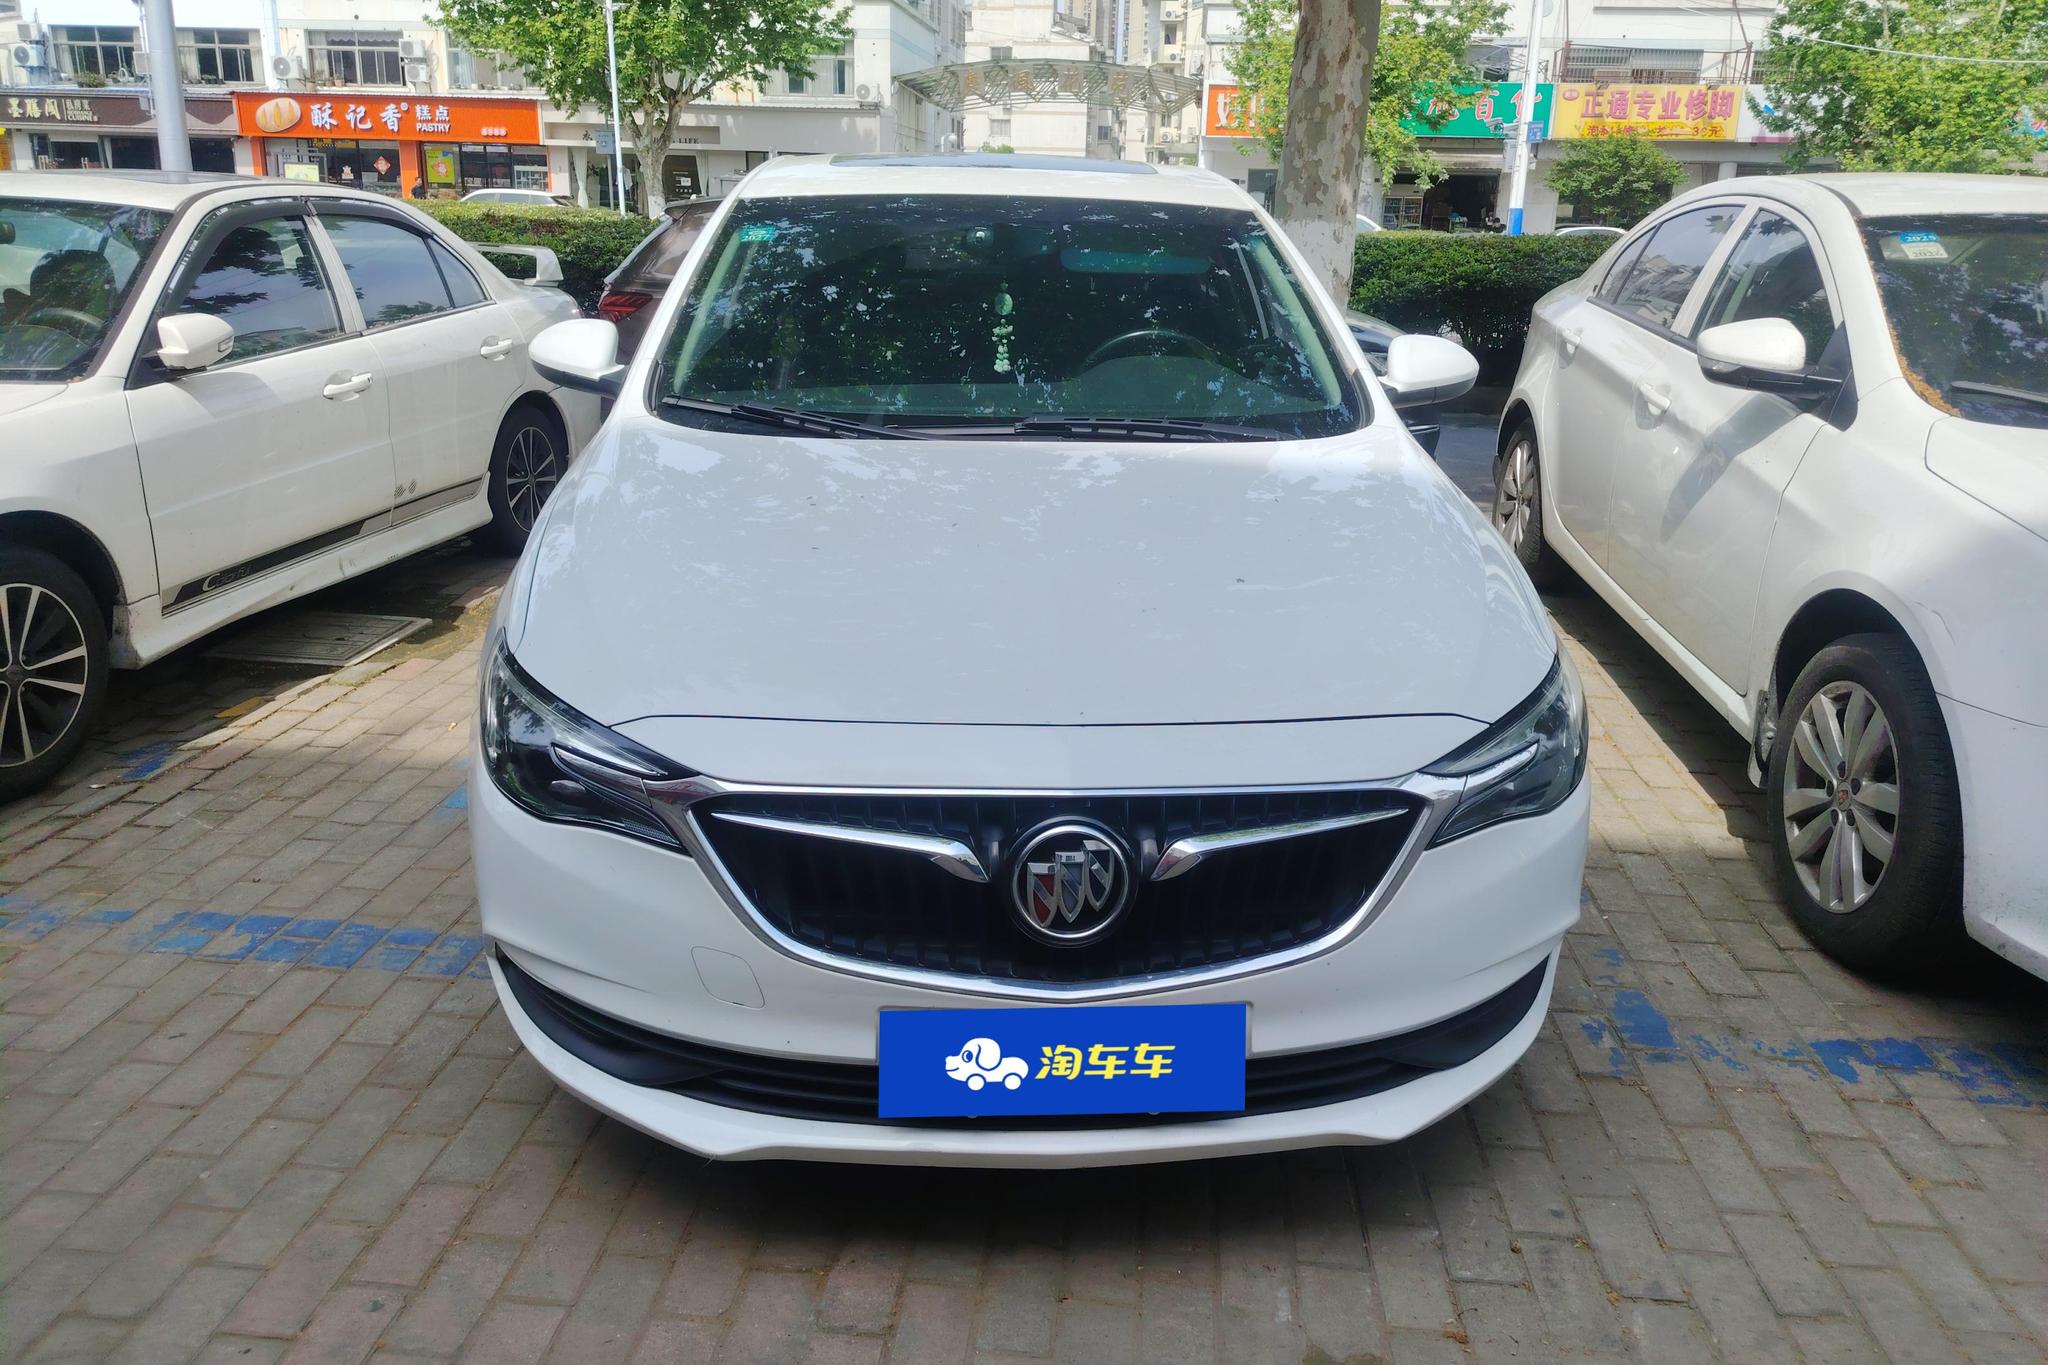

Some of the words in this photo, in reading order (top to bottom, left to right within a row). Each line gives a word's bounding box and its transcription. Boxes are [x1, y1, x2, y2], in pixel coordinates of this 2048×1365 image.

[415, 104, 450, 121] 糕点
[1581, 89, 1735, 121] 正通专业修脚
[310, 102, 402, 132] 酥记香
[416, 123, 450, 132] PASTRY
